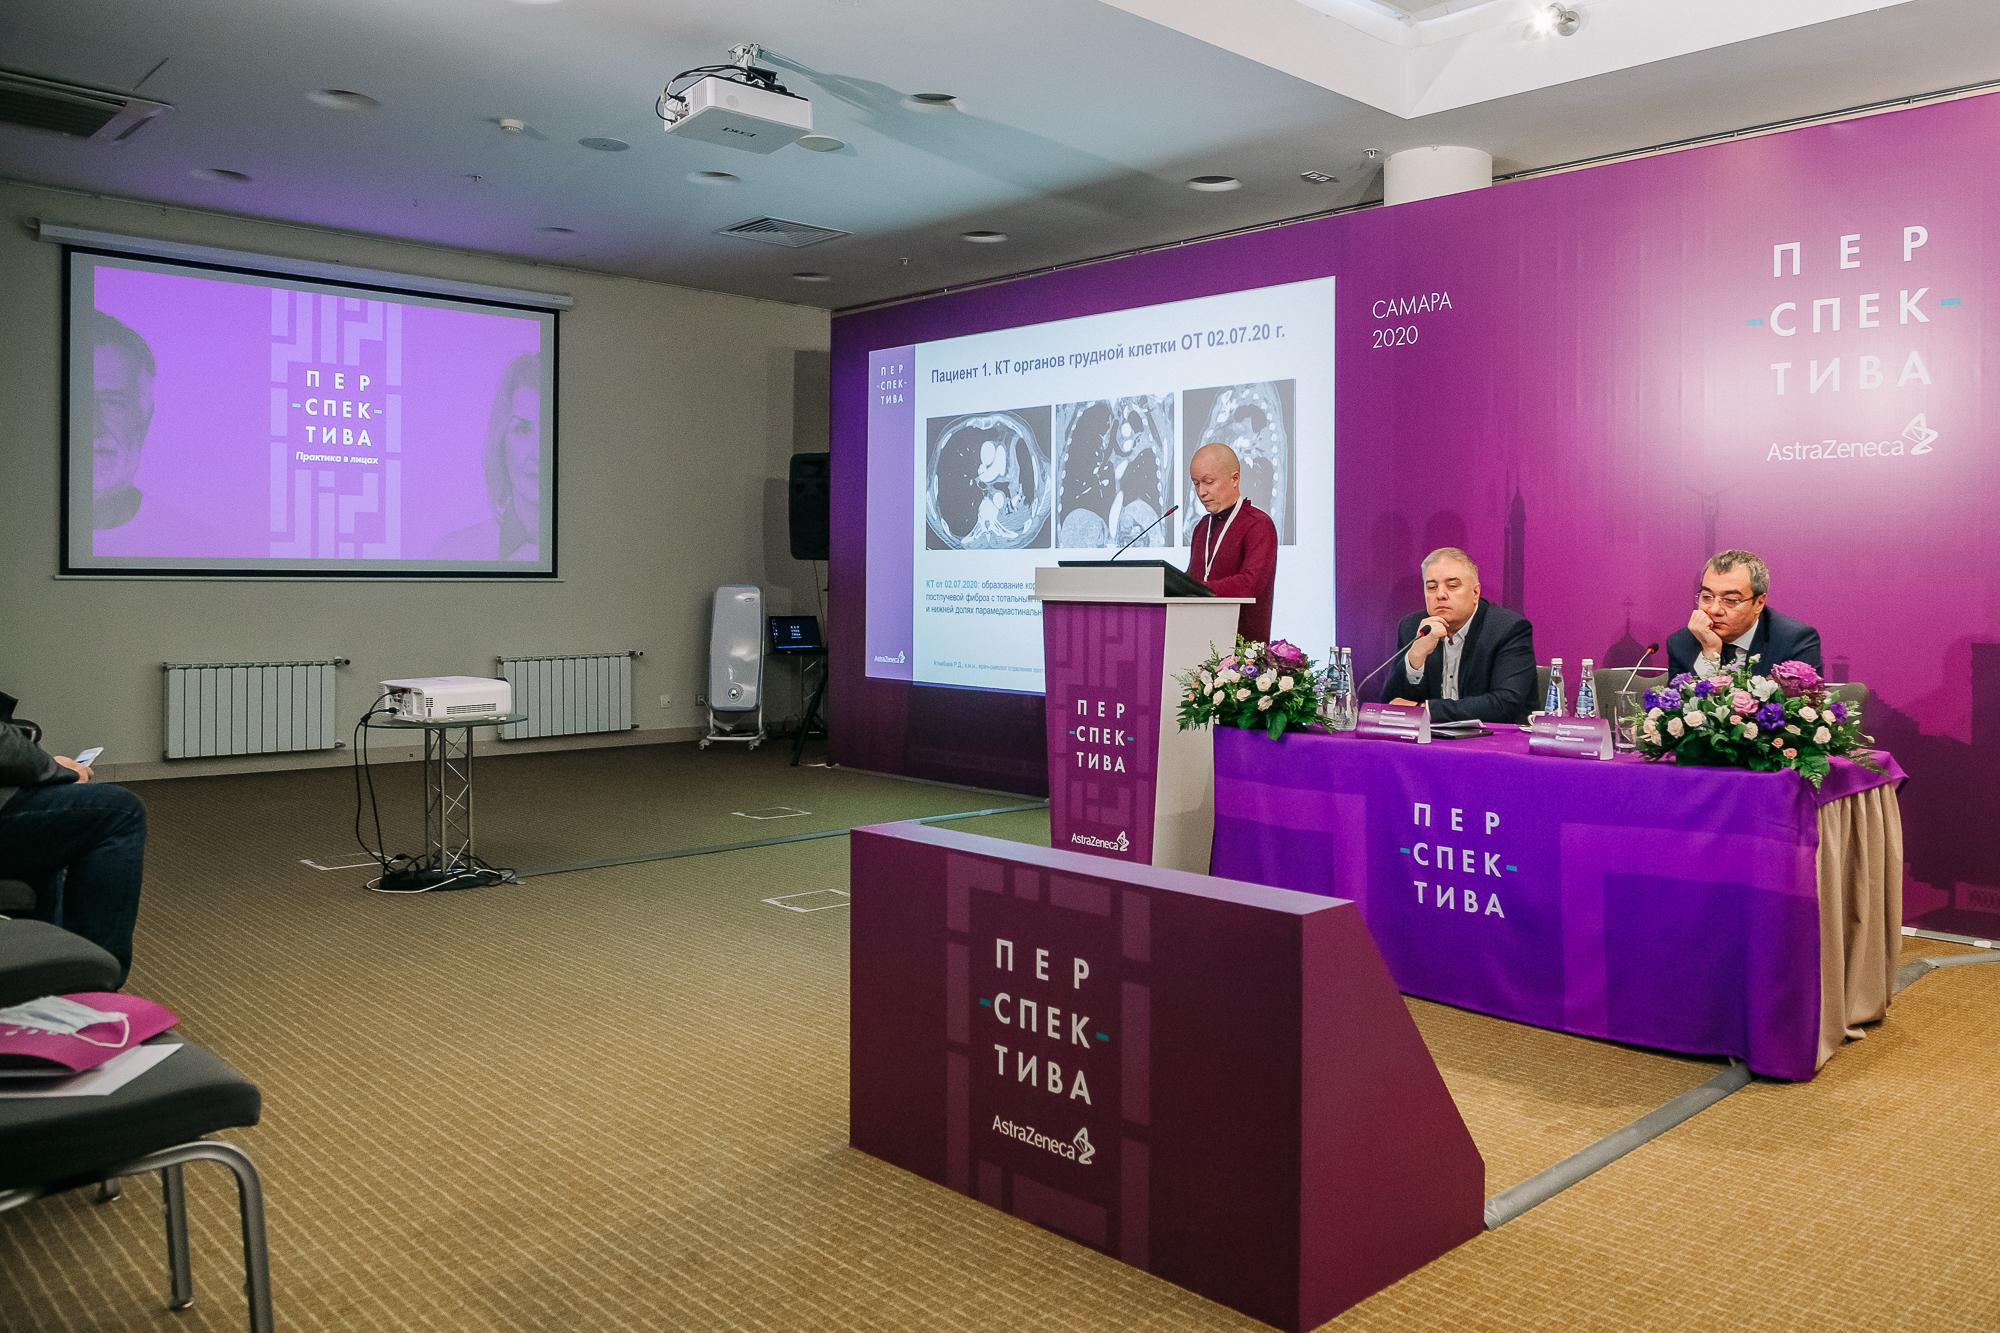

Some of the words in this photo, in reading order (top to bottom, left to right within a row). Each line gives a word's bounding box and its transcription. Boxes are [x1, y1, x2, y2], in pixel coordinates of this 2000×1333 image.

[1372, 291, 1453, 319] САМАРА
[1372, 325, 1419, 349] 2020
[931, 367, 979, 384] Пациент
[982, 362, 992, 377] 1.
[995, 359, 1011, 375] КТ
[1014, 355, 1065, 375] органов
[1069, 344, 1124, 369] грудной
[1128, 339, 1176, 358] клетки
[1181, 332, 1204, 351] ОТ
[1207, 323, 1271, 347] 02.07.20
[1770, 350, 1932, 396] ТИВА
[880, 394, 904, 405] ТИВА
[305, 426, 372, 447] ТИВА
[295, 451, 342, 463] Практика
[343, 455, 349, 463] в
[350, 456, 379, 465] лицах
[1766, 438, 1905, 462] AstraZeneca
[926, 580, 935, 588] КТ
[981, 580, 1024, 590] образование
[926, 593, 964, 603] постлучевой
[965, 593, 989, 604] фиброз
[931, 605, 954, 613] нижней
[955, 606, 974, 614] долях
[1076, 752, 1126, 773] ТИВА
[1071, 832, 1118, 851] AstraZeneca
[1413, 880, 1505, 919] ТИВА
[994, 1043, 1092, 1106] ТИВА
[992, 1114, 1075, 1161] AstraZeneca
